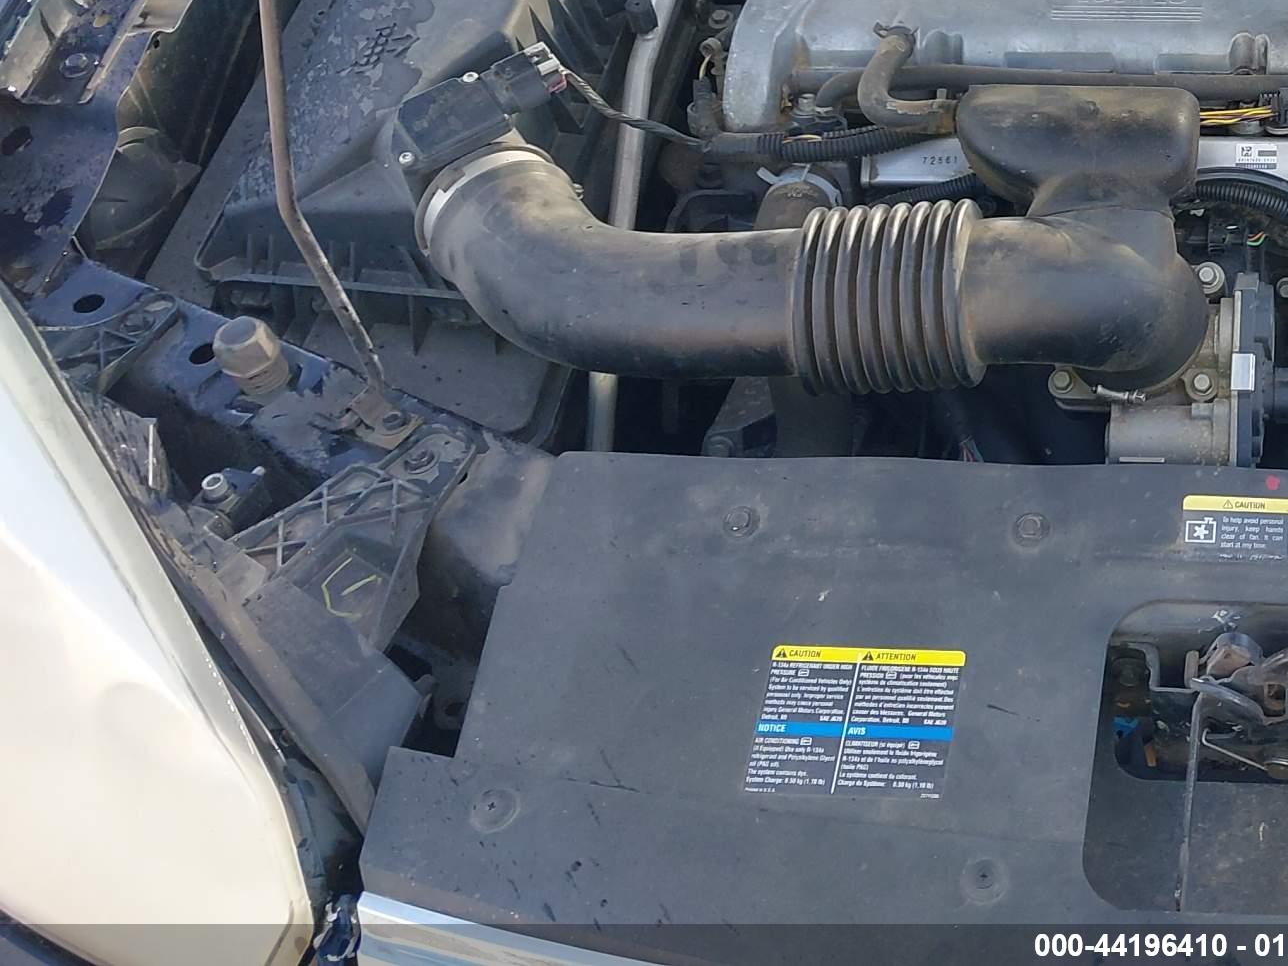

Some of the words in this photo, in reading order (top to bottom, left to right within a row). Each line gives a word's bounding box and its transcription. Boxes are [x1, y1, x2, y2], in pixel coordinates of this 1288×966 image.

[789, 650, 821, 658] CAUTION
[758, 724, 786, 732] NOTICE
[847, 727, 866, 735] AVIS
